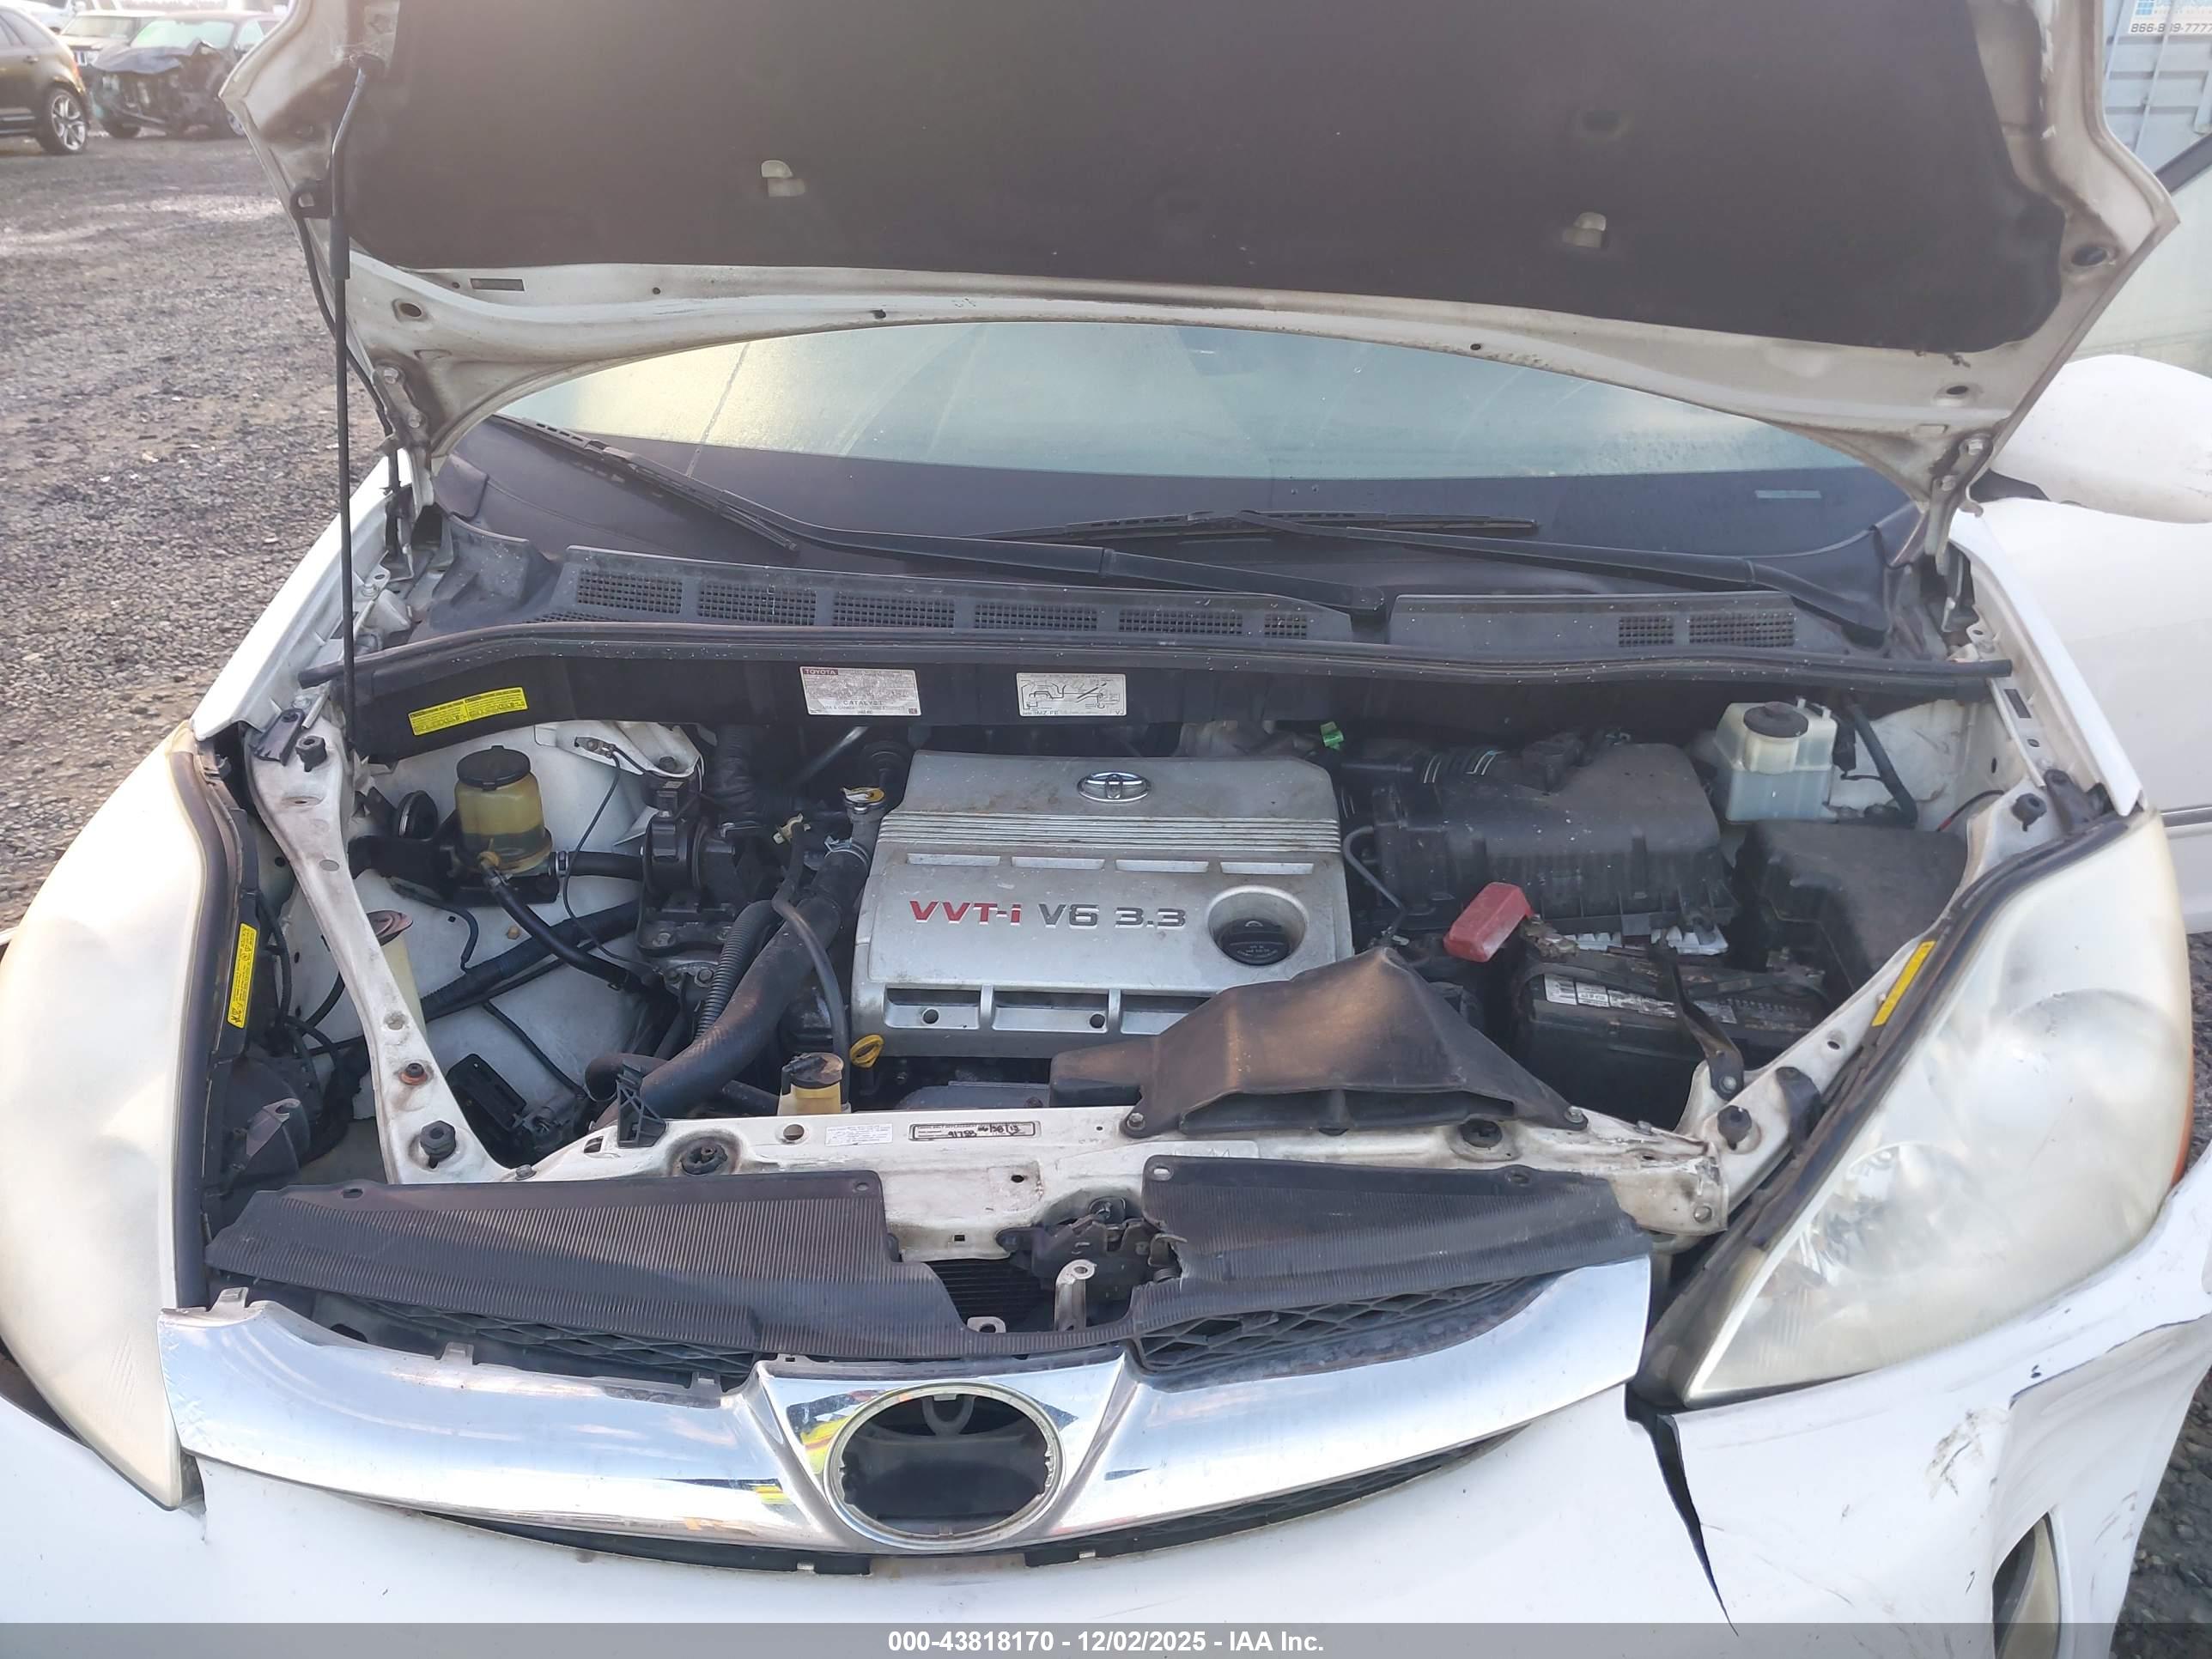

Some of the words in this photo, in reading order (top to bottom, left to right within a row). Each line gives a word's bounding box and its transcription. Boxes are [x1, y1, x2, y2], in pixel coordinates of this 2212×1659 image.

[908, 900, 1023, 925] VVT-i
[1038, 903, 1099, 928] V6
[1115, 907, 1187, 928] 3.3
